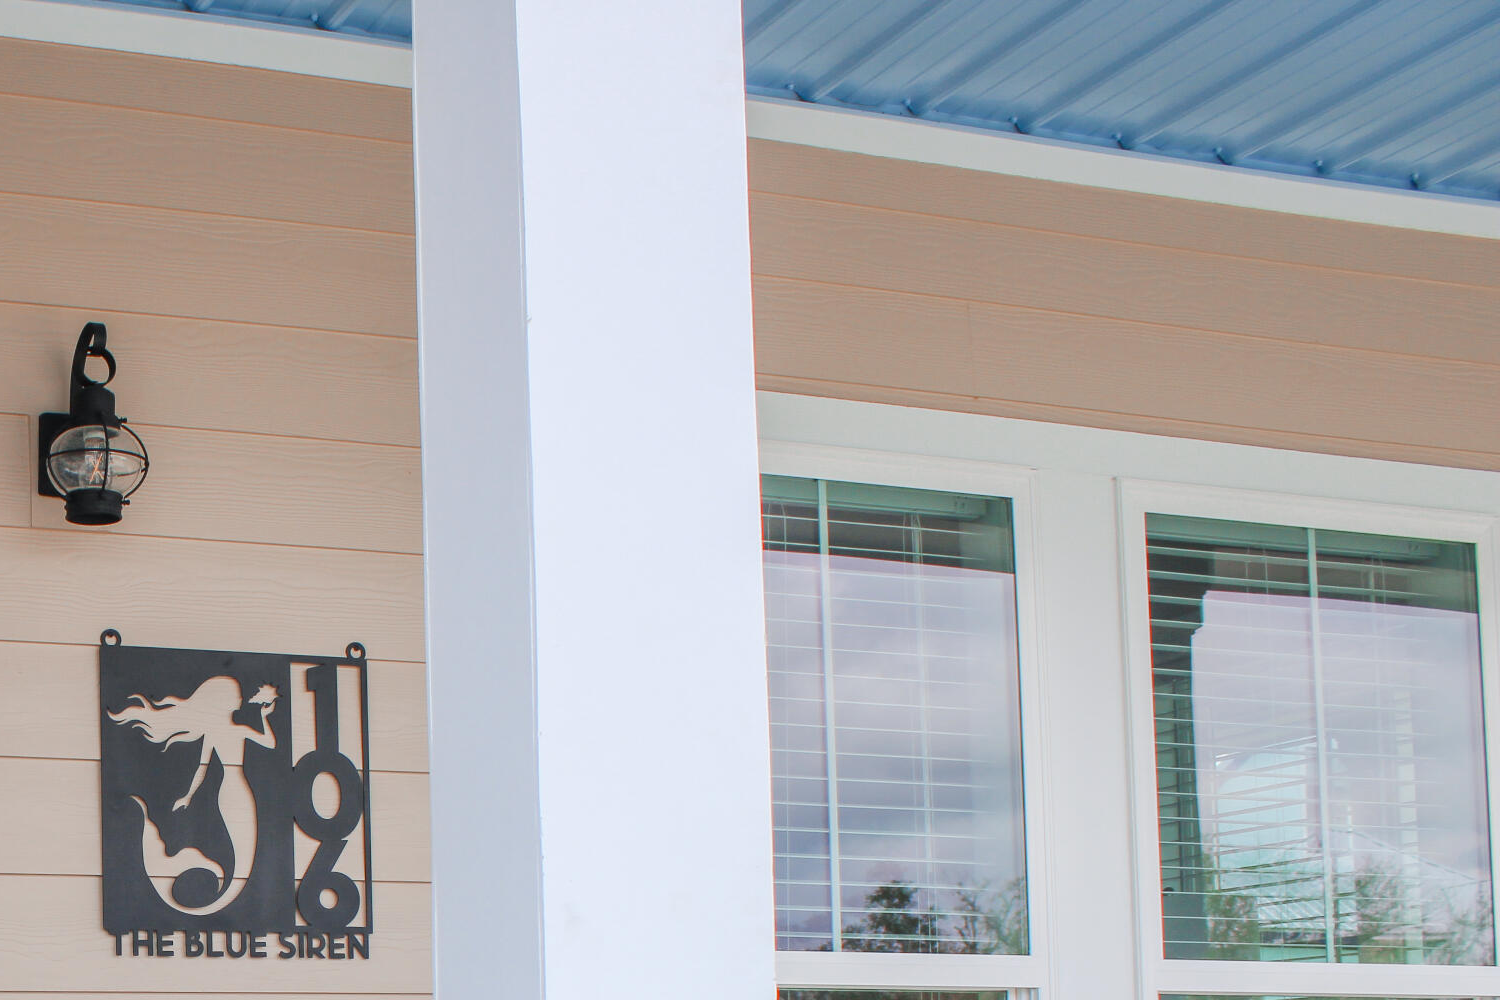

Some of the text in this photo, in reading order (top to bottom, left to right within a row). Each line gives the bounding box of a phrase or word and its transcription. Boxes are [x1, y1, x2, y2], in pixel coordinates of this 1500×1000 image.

[293, 663, 364, 927] 1096
[109, 929, 369, 959] THE BLUE SIREN
